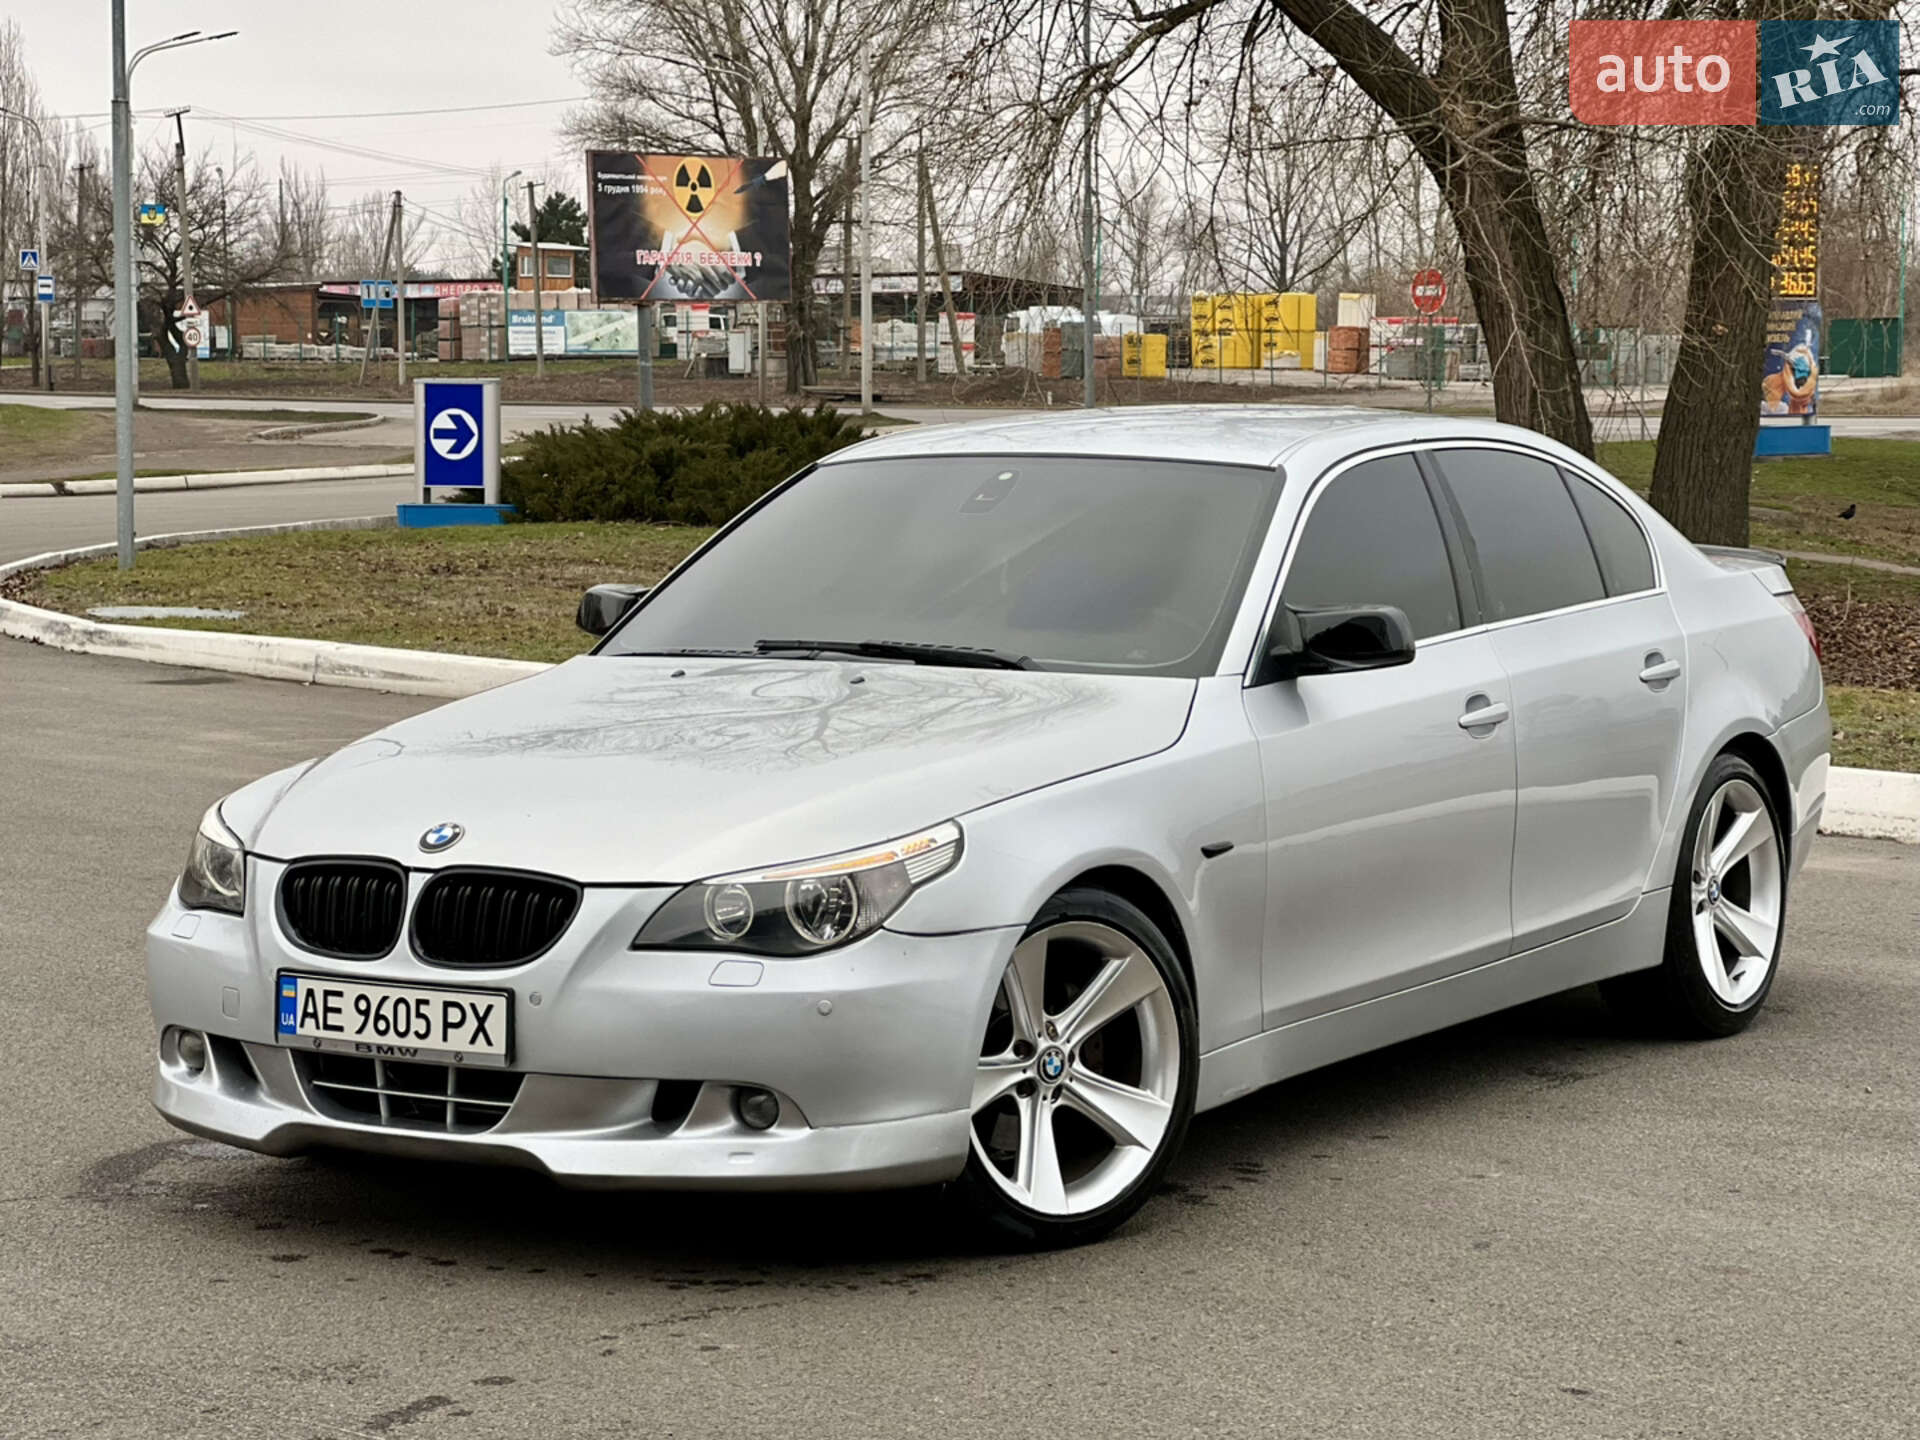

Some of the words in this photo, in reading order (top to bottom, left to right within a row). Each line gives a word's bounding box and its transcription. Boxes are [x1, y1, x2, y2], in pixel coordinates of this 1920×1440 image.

[511, 313, 553, 323] Bruklnd
[187, 332, 198, 342] 40
[281, 1012, 295, 1026] UA
[299, 987, 345, 1032] AE
[354, 993, 432, 1040] 9605
[441, 1000, 495, 1047] PX
[355, 1043, 419, 1057] BMW
